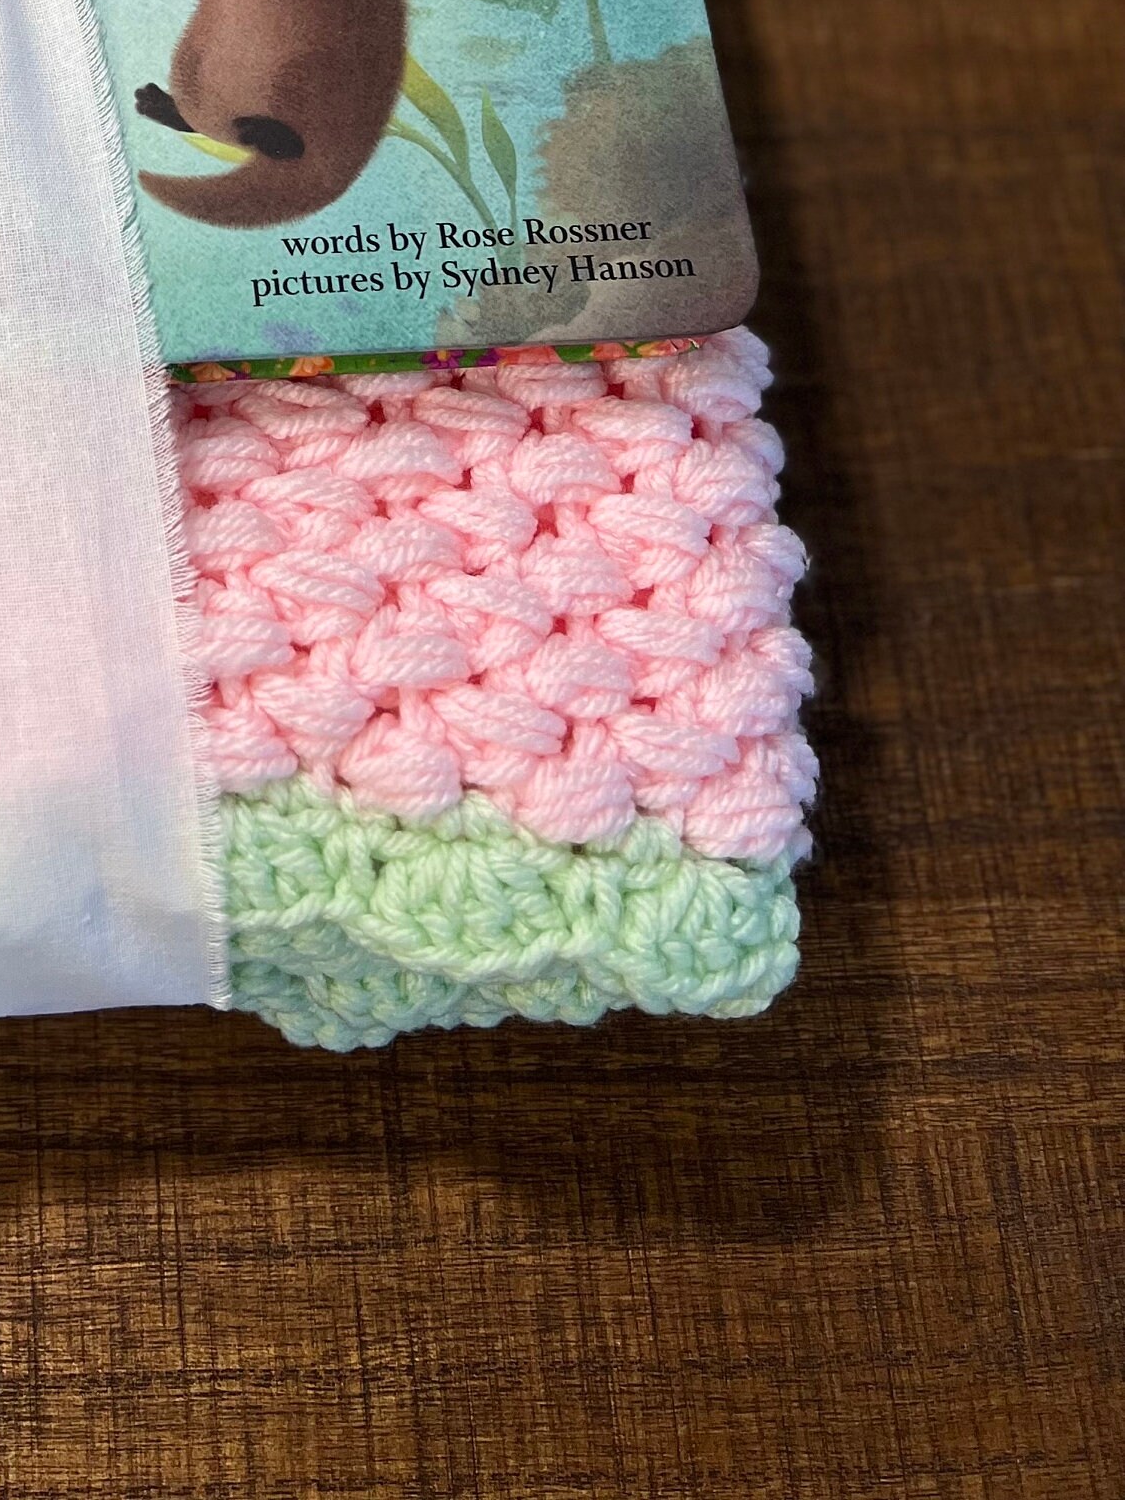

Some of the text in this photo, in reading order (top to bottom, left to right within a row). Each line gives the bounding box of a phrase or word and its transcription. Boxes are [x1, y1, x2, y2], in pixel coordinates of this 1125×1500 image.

[281, 217, 653, 260] words by Rose Rossner
[251, 252, 697, 306] pictures by Sydney Hanson
